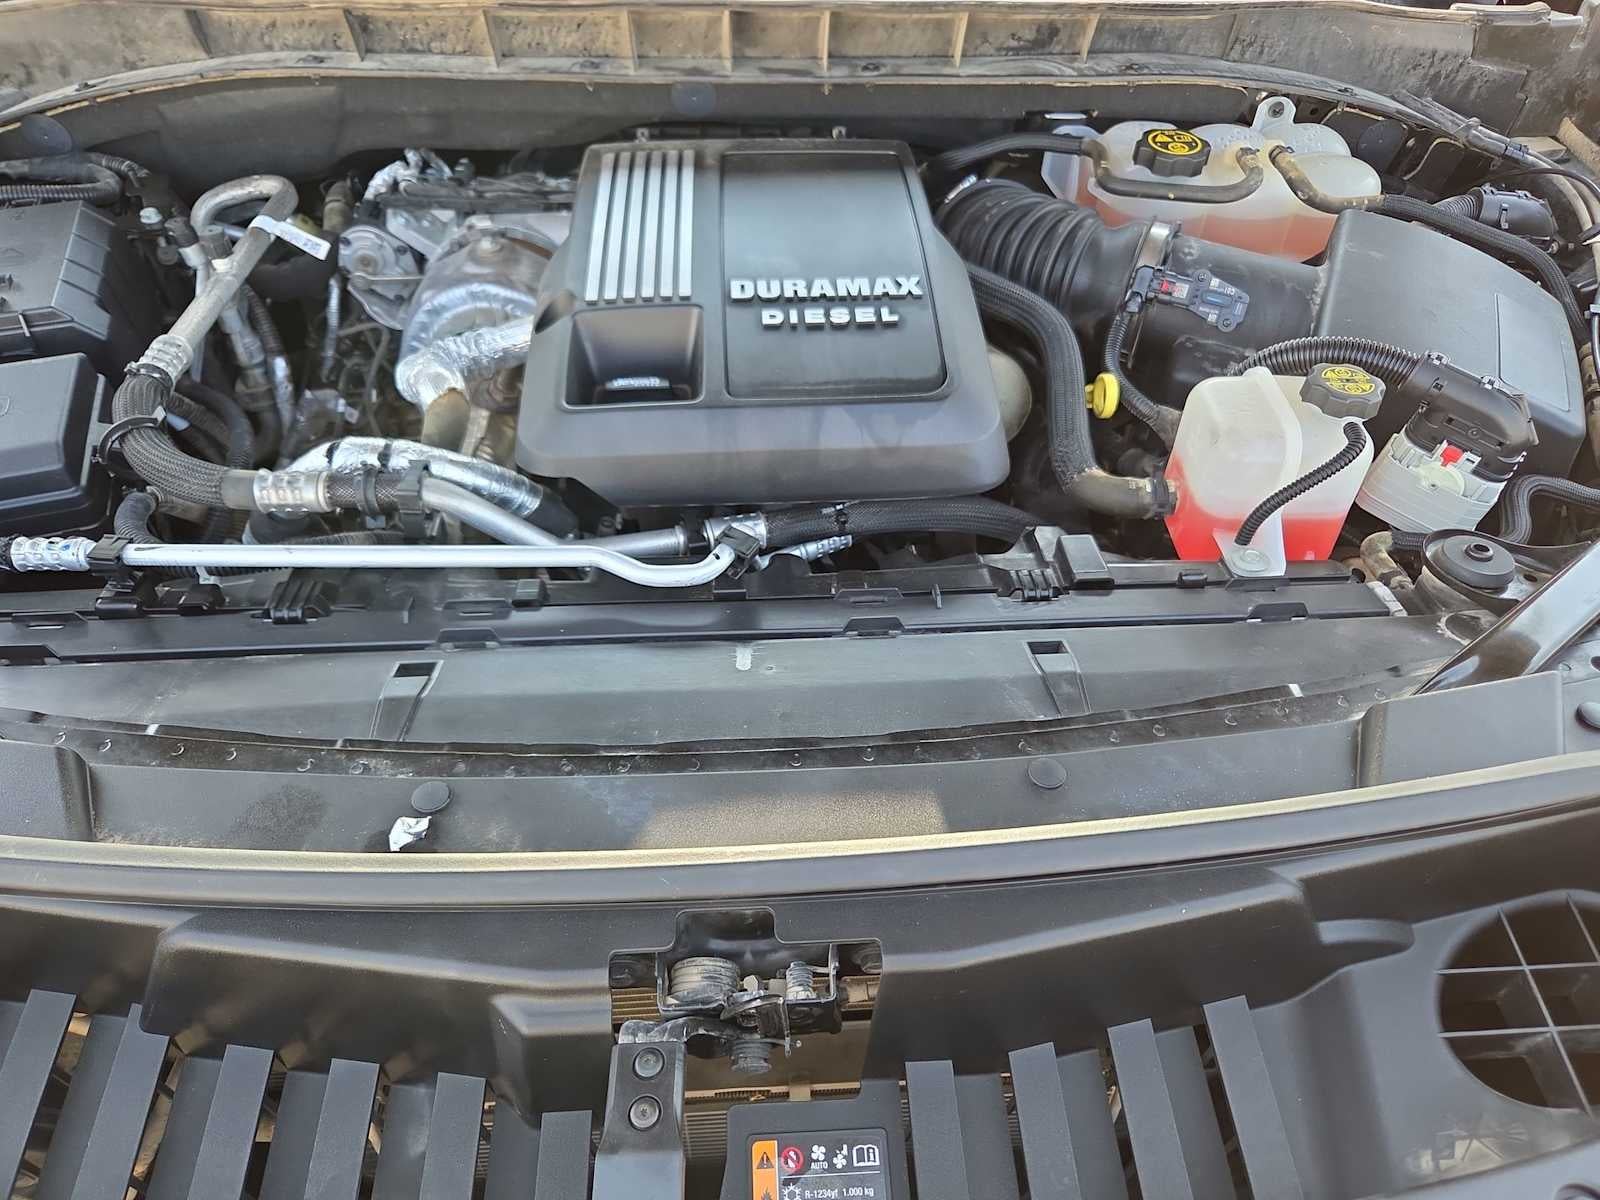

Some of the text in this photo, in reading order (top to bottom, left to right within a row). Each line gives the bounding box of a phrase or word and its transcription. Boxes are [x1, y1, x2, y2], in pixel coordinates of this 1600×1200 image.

[730, 276, 923, 301] DURAMAX
[761, 306, 900, 327] DIESEL
[810, 1161, 829, 1170] AUTO
[864, 1186, 874, 1197] kg
